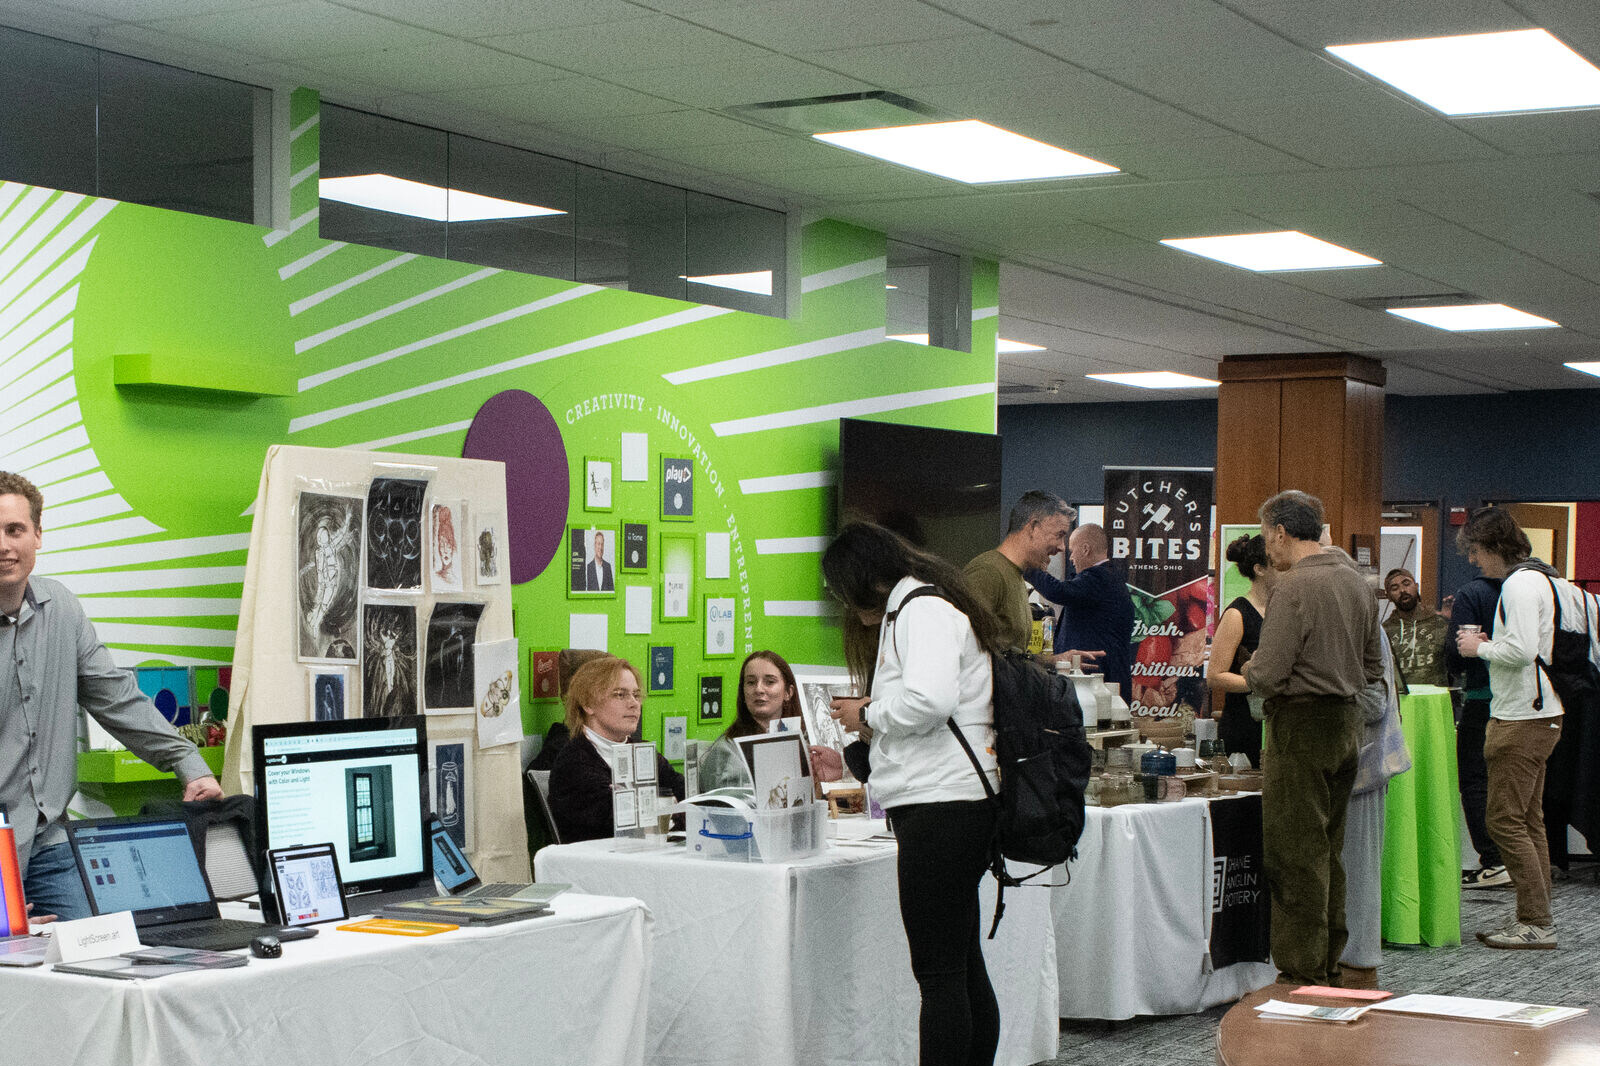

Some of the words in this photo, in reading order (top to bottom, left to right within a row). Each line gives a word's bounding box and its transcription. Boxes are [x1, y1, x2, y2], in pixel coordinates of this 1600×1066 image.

[1112, 479, 1202, 532] BUTCHER'S
[565, 393, 646, 425] CREATIVITY
[656, 405, 725, 499] INNOVATION
[726, 512, 754, 654] ENTREPRENE
[1112, 537, 1202, 561] BITES
[1128, 564, 1162, 572] ATHENS,
[1163, 564, 1184, 572] OHIO
[718, 610, 732, 619] LAB
[1130, 619, 1185, 637] Fresh.
[1130, 660, 1200, 678] tritious.
[1399, 653, 1435, 669] ITES
[1129, 699, 1183, 718] Local.
